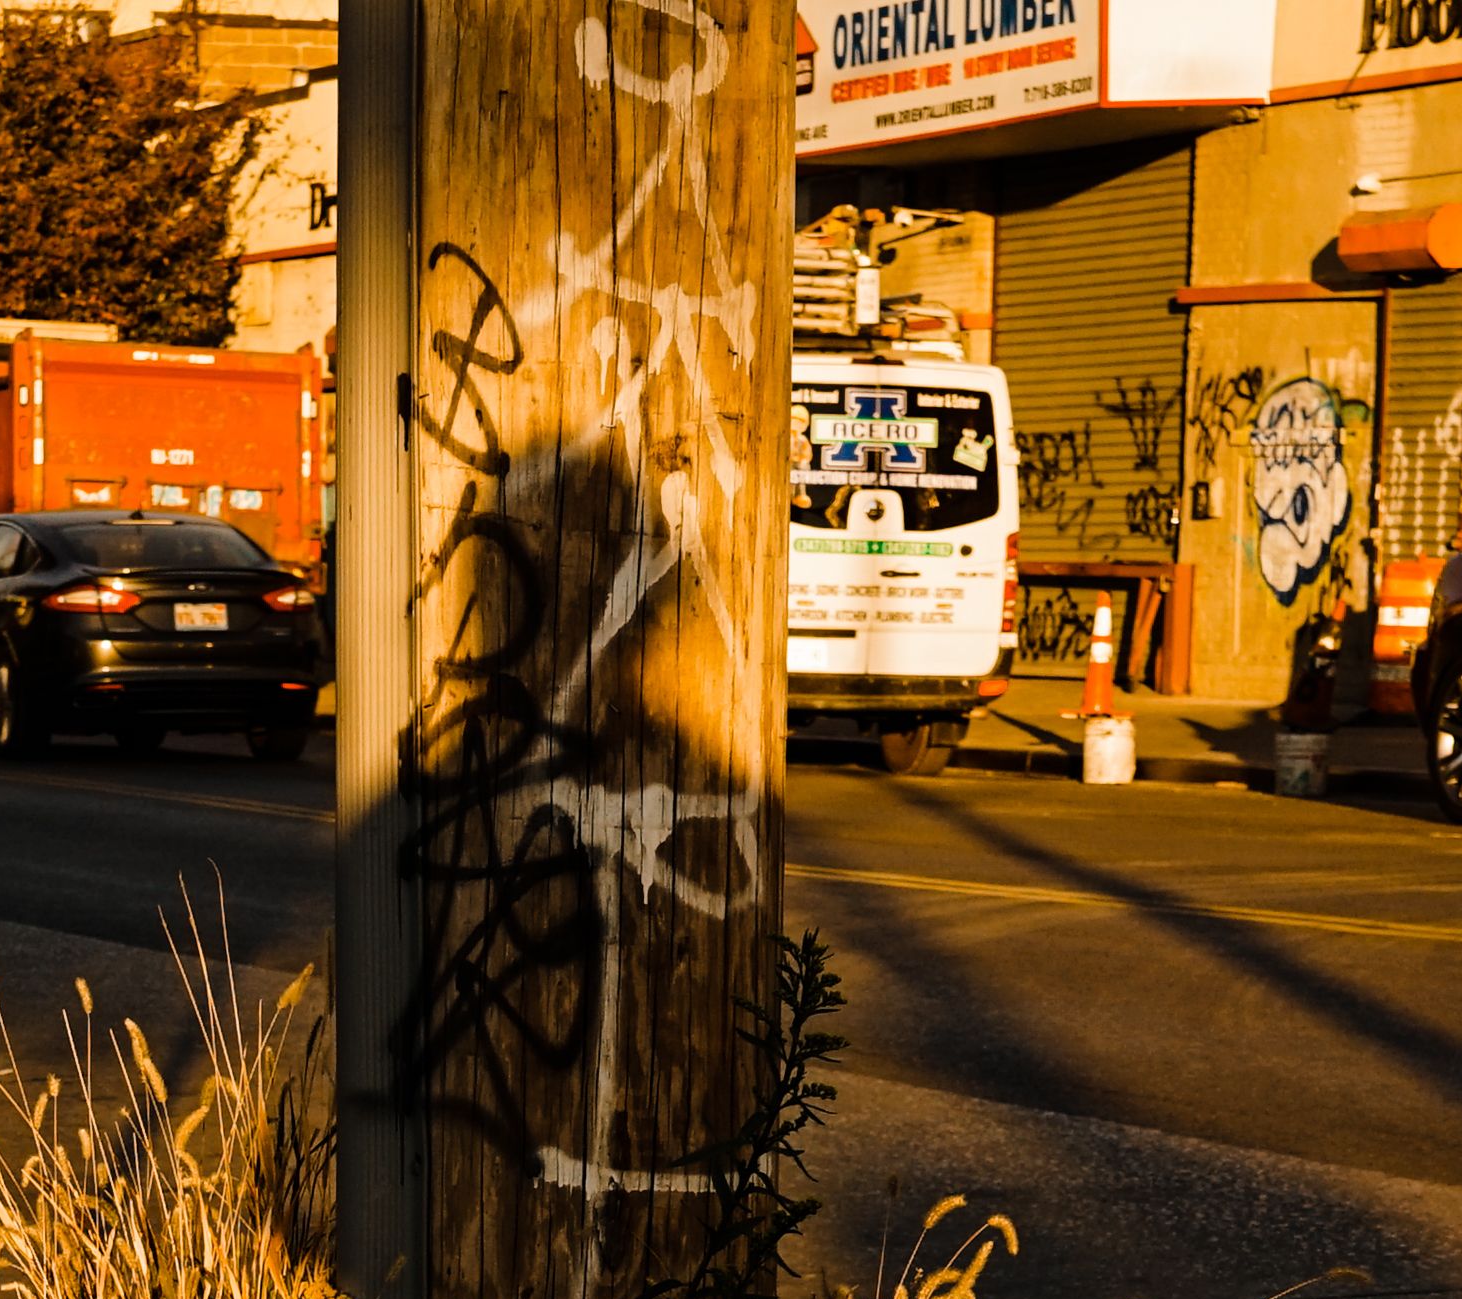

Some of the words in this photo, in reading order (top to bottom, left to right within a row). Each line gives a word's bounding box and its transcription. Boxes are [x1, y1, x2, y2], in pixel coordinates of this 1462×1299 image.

[833, 0, 956, 70] ORIENTAL
[832, 74, 889, 104] CERTIFIED
[833, 422, 918, 441] ACERO
